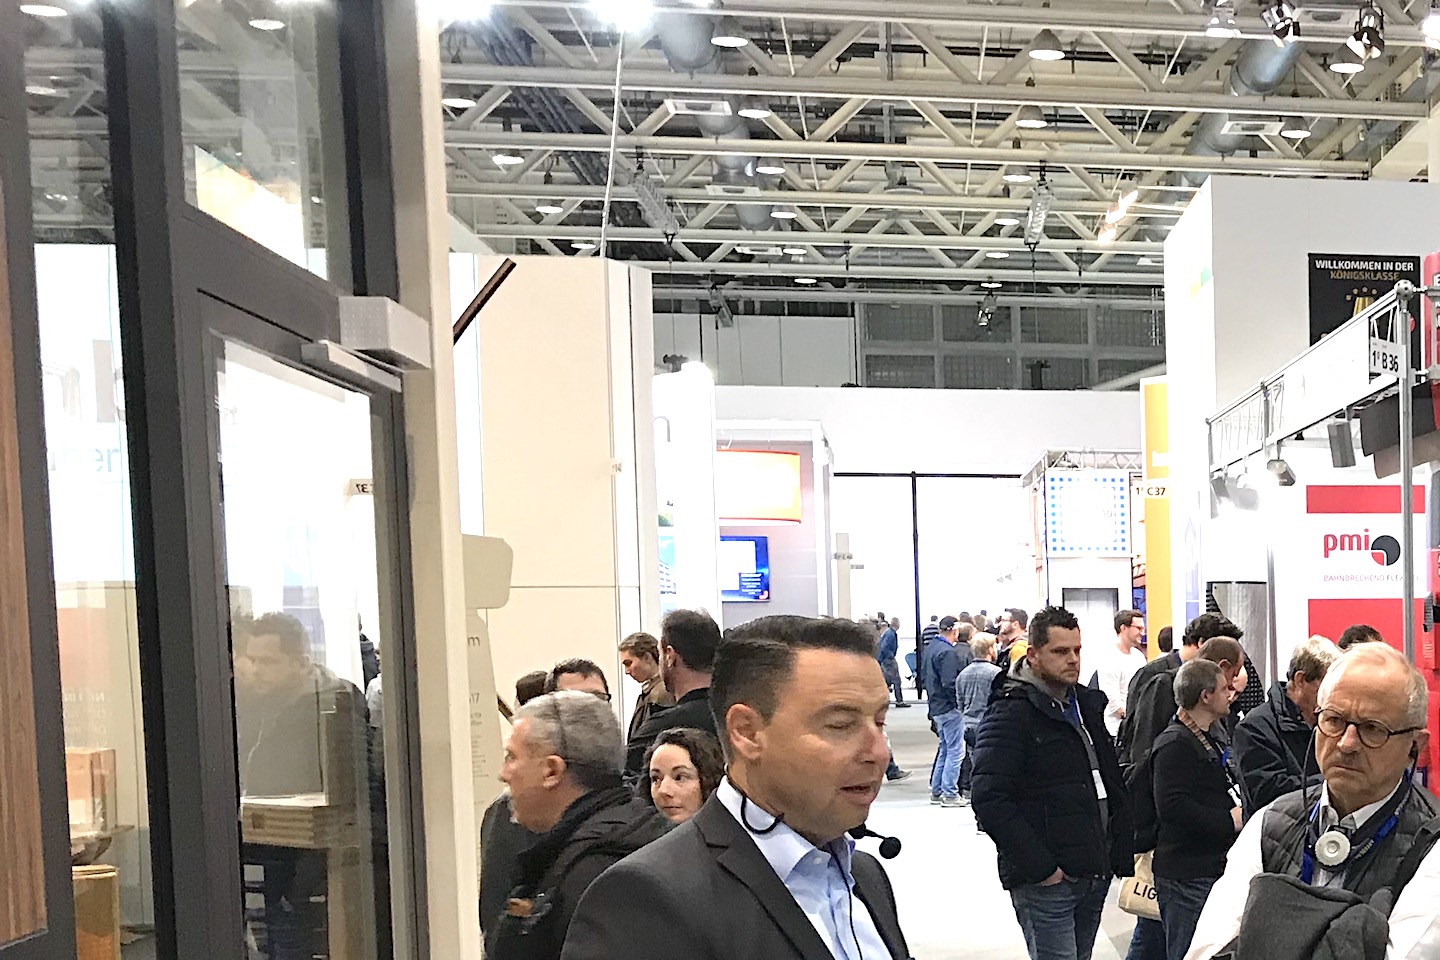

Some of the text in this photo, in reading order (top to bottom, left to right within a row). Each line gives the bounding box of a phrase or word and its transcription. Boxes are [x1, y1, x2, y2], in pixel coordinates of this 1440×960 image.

[1314, 259, 1414, 272] WILLKOMMEN IN DER
[1323, 528, 1370, 558] pmi
